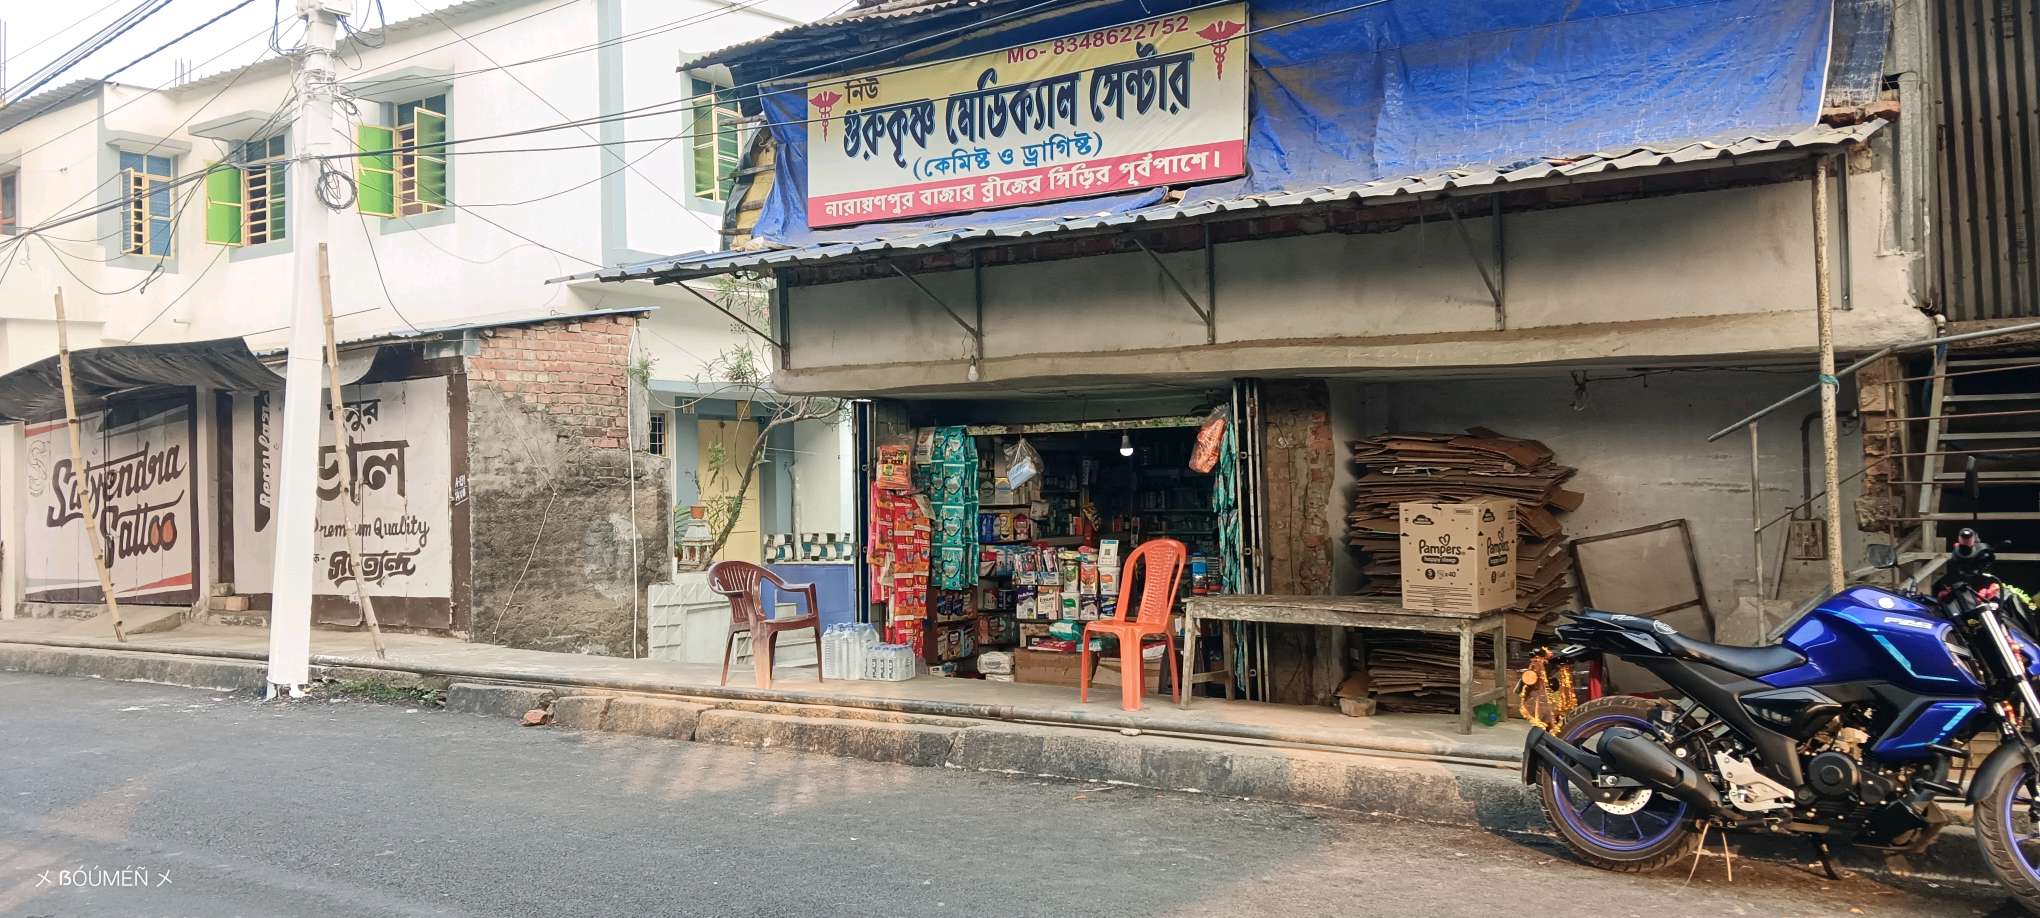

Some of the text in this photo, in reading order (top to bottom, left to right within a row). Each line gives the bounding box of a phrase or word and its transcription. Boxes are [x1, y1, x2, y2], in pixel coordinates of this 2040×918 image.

[1007, 15, 1189, 64] Mo- 8348622752
[843, 41, 1195, 169] গুরুকৃষ্ণ মেডিক্যাল সেন্টার
[844, 77, 880, 104] নিউ
[998, 148, 1014, 166] ও
[825, 191, 915, 217] নারায়ণপুর
[919, 183, 976, 205] বাজার
[374, 515, 430, 548] Quality
[1419, 539, 1462, 556] Pampers
